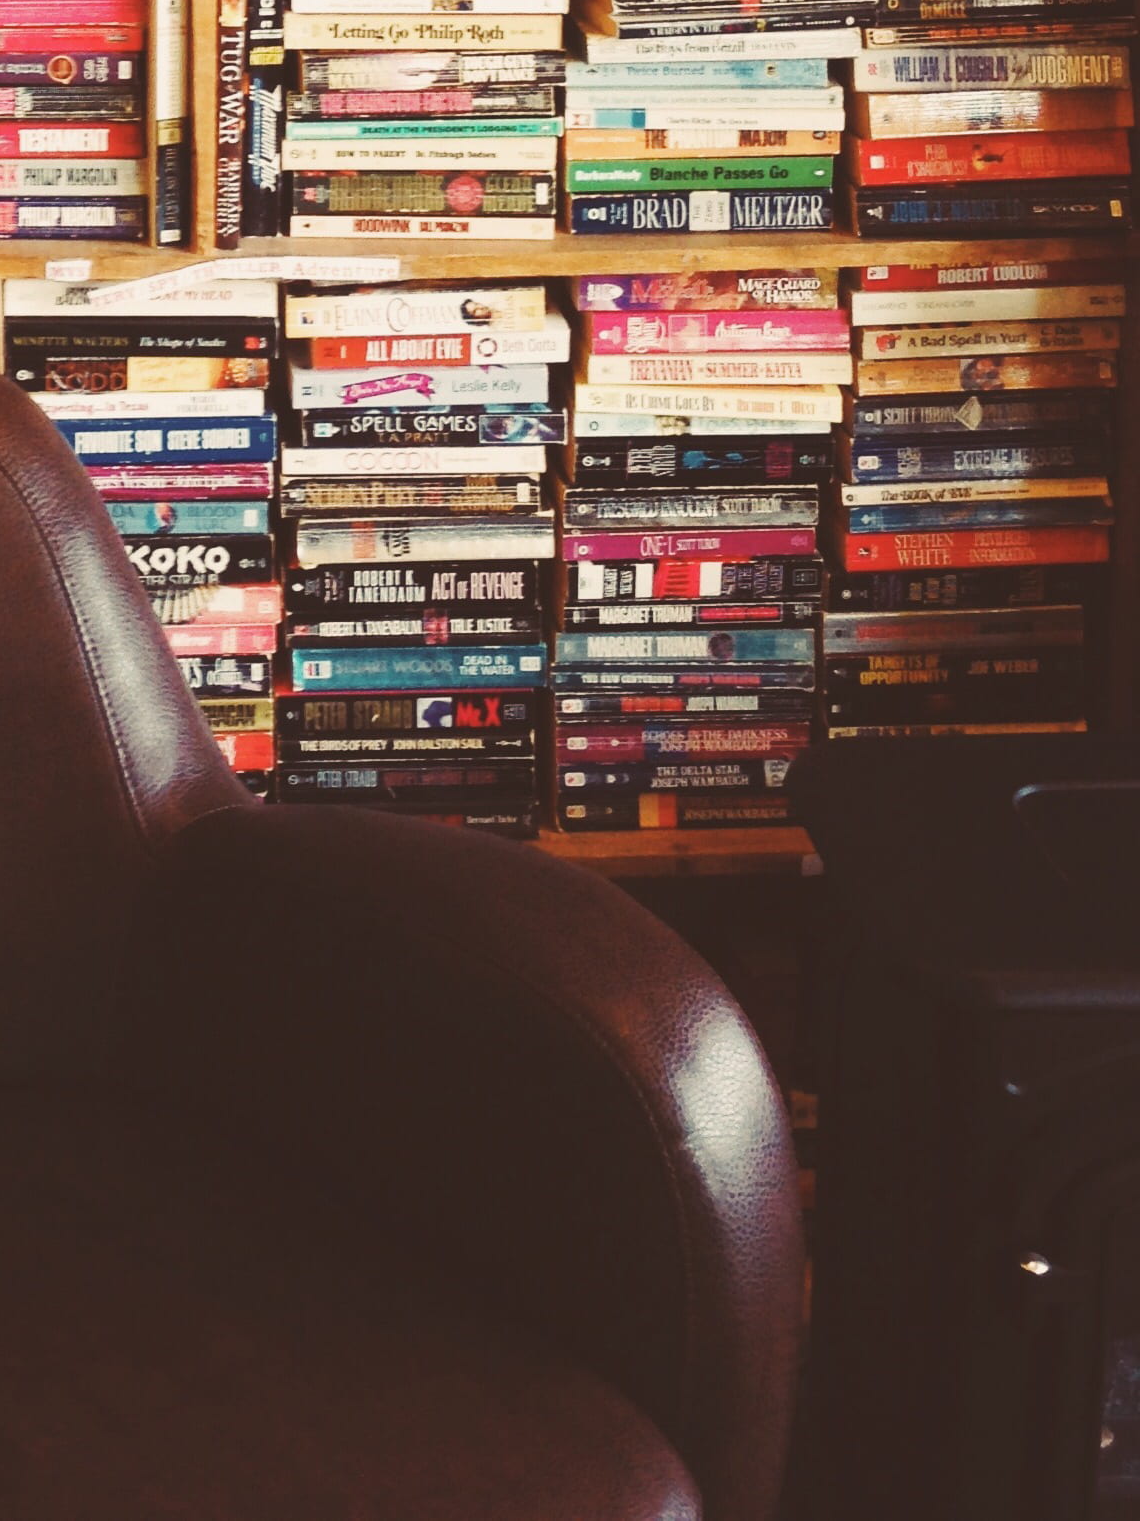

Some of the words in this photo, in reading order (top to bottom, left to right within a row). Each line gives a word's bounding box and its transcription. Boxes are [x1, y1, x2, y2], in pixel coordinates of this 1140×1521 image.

[327, 23, 384, 42] Letting
[388, 23, 408, 43] Go
[415, 22, 464, 42] Philip
[467, 23, 504, 41] Roth
[220, 32, 246, 82] TUG
[1029, 55, 1110, 78] JUDGMENT
[219, 91, 241, 145] WAR
[651, 166, 709, 180] Blanche
[714, 166, 764, 180] Passes
[769, 165, 789, 178] Go
[633, 198, 687, 228] BRAD
[733, 195, 824, 227] MELTZER
[365, 342, 388, 361] ALL
[391, 339, 435, 360] ABOUT
[439, 339, 463, 358] EVIE
[452, 379, 487, 392] Leslie
[492, 378, 521, 394] Kelly
[350, 416, 406, 433] SPELL
[414, 414, 477, 432] GAMES
[895, 535, 953, 549] STEPHEN
[125, 545, 230, 574] KOKO
[897, 548, 952, 564] WHITE
[353, 571, 400, 586] ROBERT
[404, 571, 417, 585] K.
[432, 574, 456, 600] ACT
[471, 572, 525, 600] REVENGE
[349, 587, 426, 603] TANENBAUM
